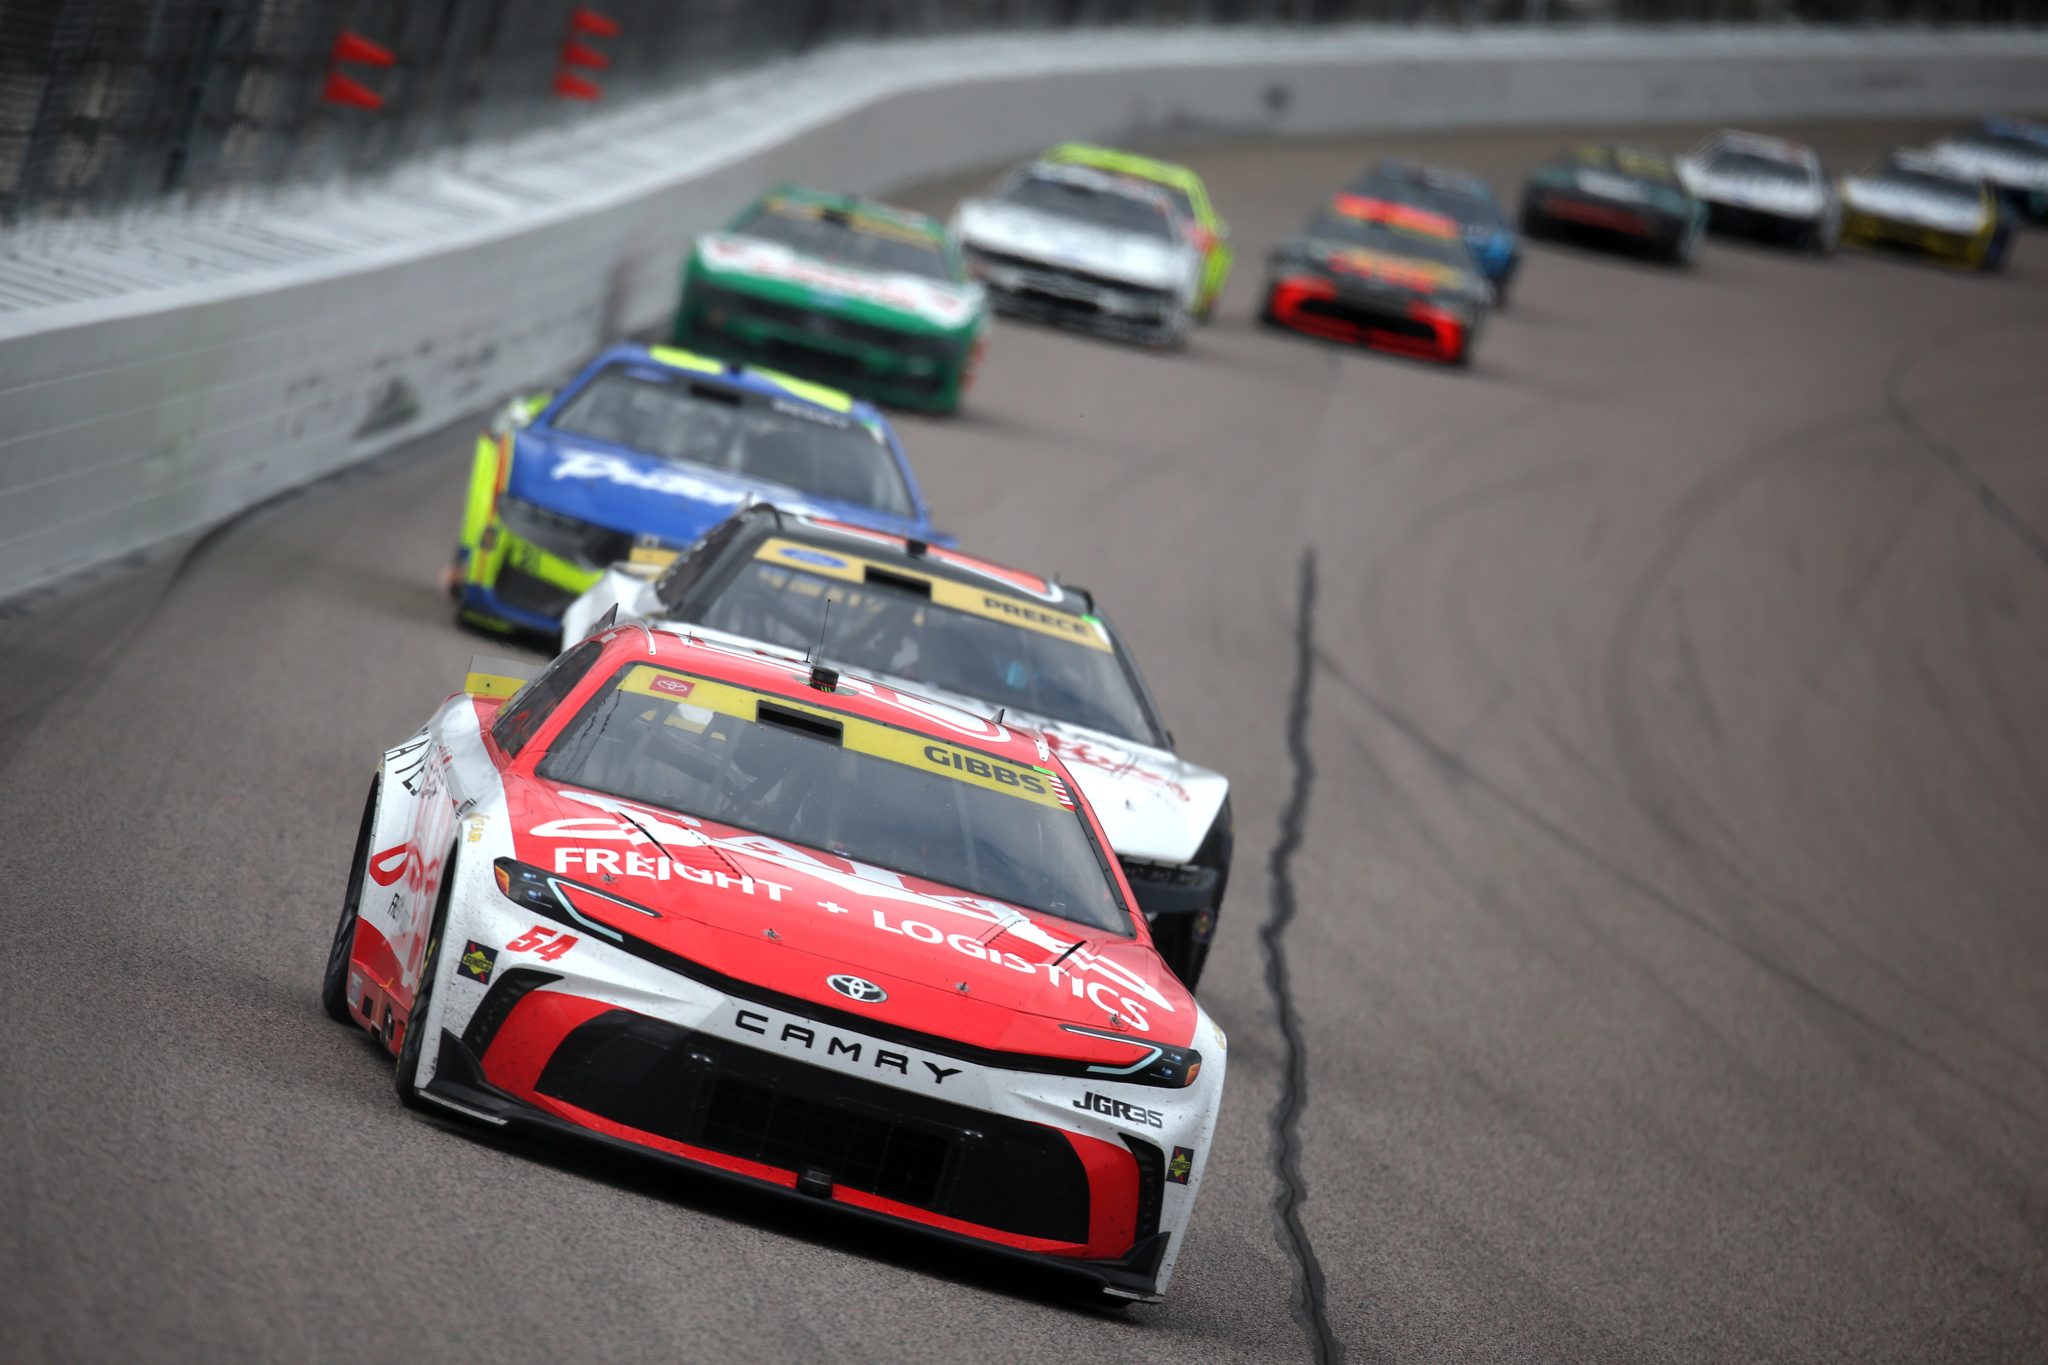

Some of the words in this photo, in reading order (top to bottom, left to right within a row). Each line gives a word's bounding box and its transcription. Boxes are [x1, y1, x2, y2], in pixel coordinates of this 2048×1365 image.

[983, 596, 1087, 637] PREECE
[924, 745, 1046, 794] GIBBS
[529, 790, 1175, 1012] SAIA
[505, 925, 579, 962] 54
[554, 847, 793, 901] FREIGHT
[872, 909, 1150, 1032] LOGISTICS
[735, 1009, 963, 1084] CAMRY
